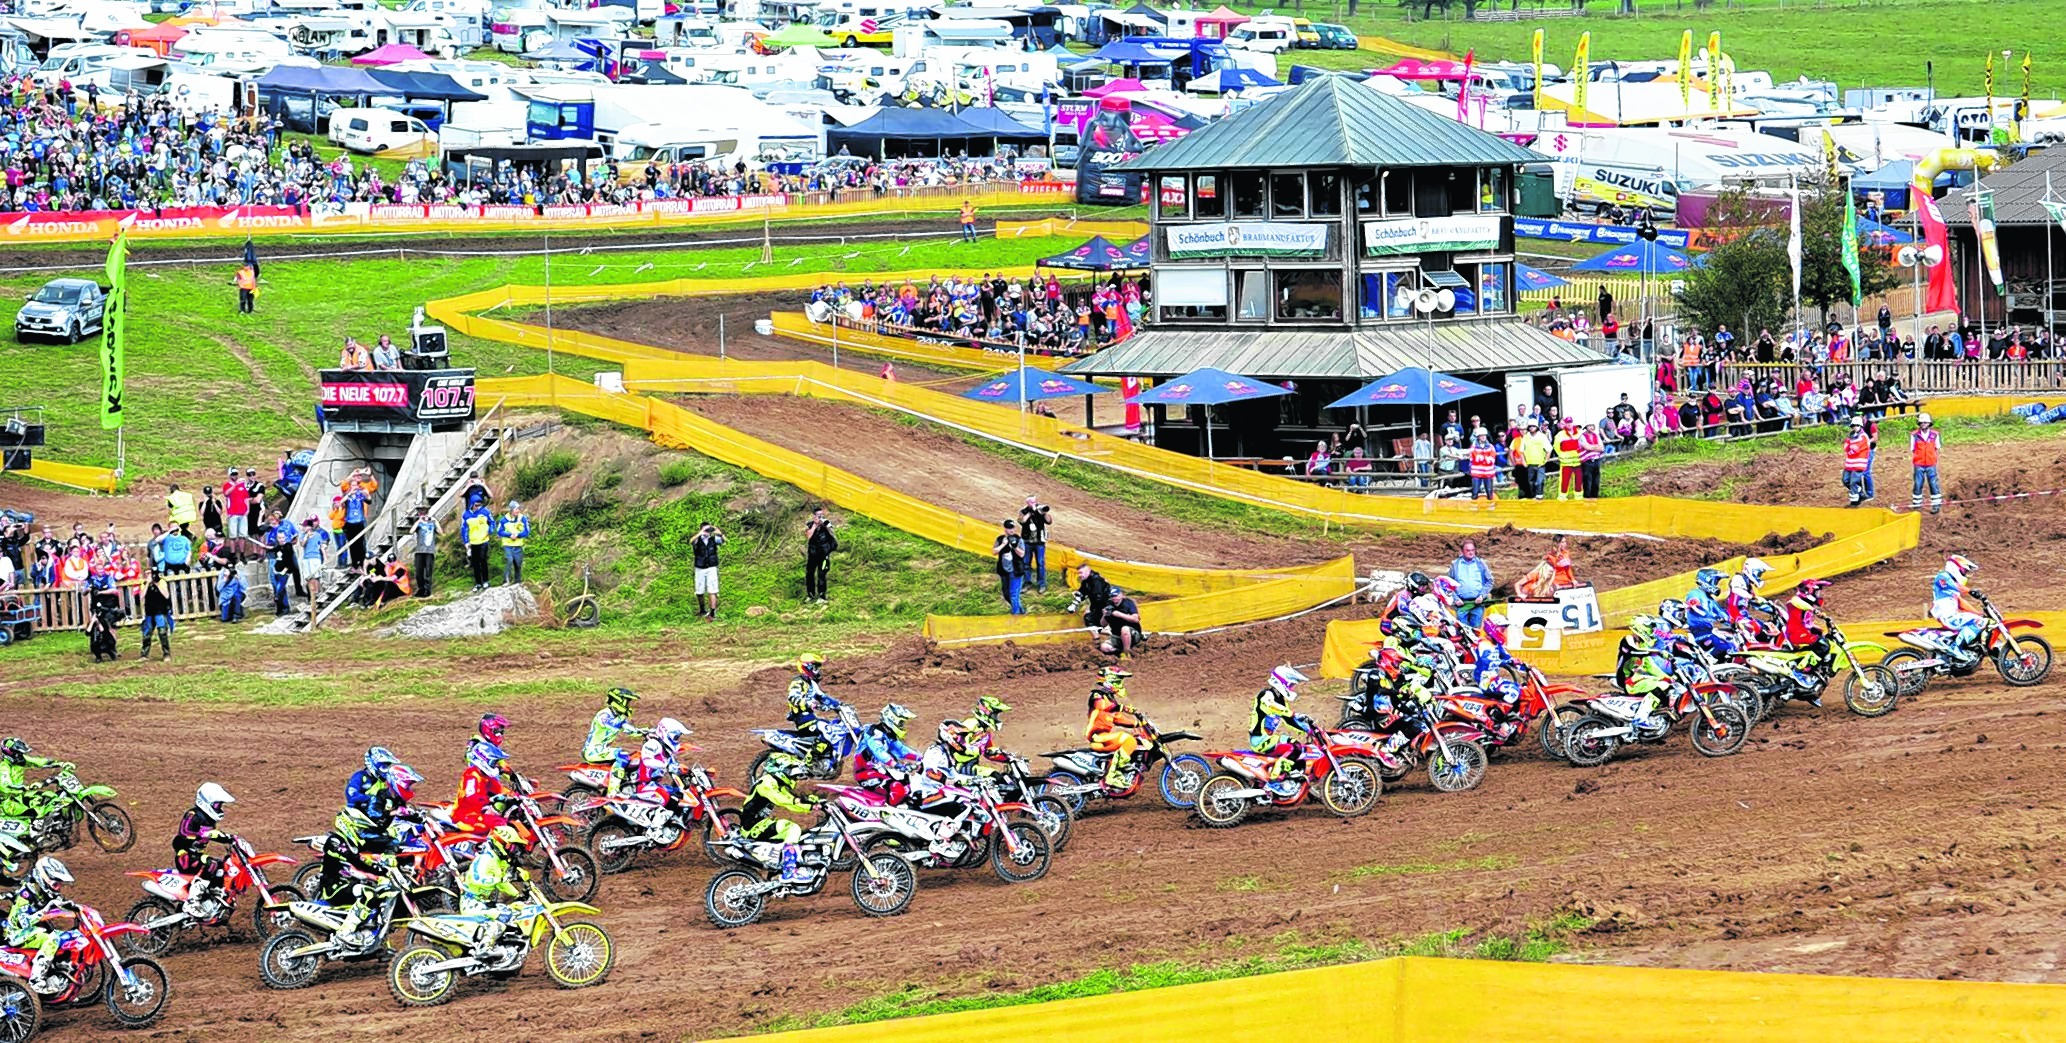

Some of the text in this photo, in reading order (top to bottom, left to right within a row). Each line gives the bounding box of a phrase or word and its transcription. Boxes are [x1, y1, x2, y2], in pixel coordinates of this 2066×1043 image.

[292, 30, 327, 43] NOLAN
[1594, 168, 1660, 195] SUZUKI
[29, 221, 100, 234] HONDA
[136, 217, 204, 231] HONDA
[238, 215, 305, 228] HONDA
[1179, 231, 1225, 244] Schönbuch
[1375, 226, 1417, 239] Schönbuch
[321, 387, 405, 403] DIE NEUE 107.7
[423, 386, 475, 408] 107.7
[1521, 617, 1548, 648] 5
